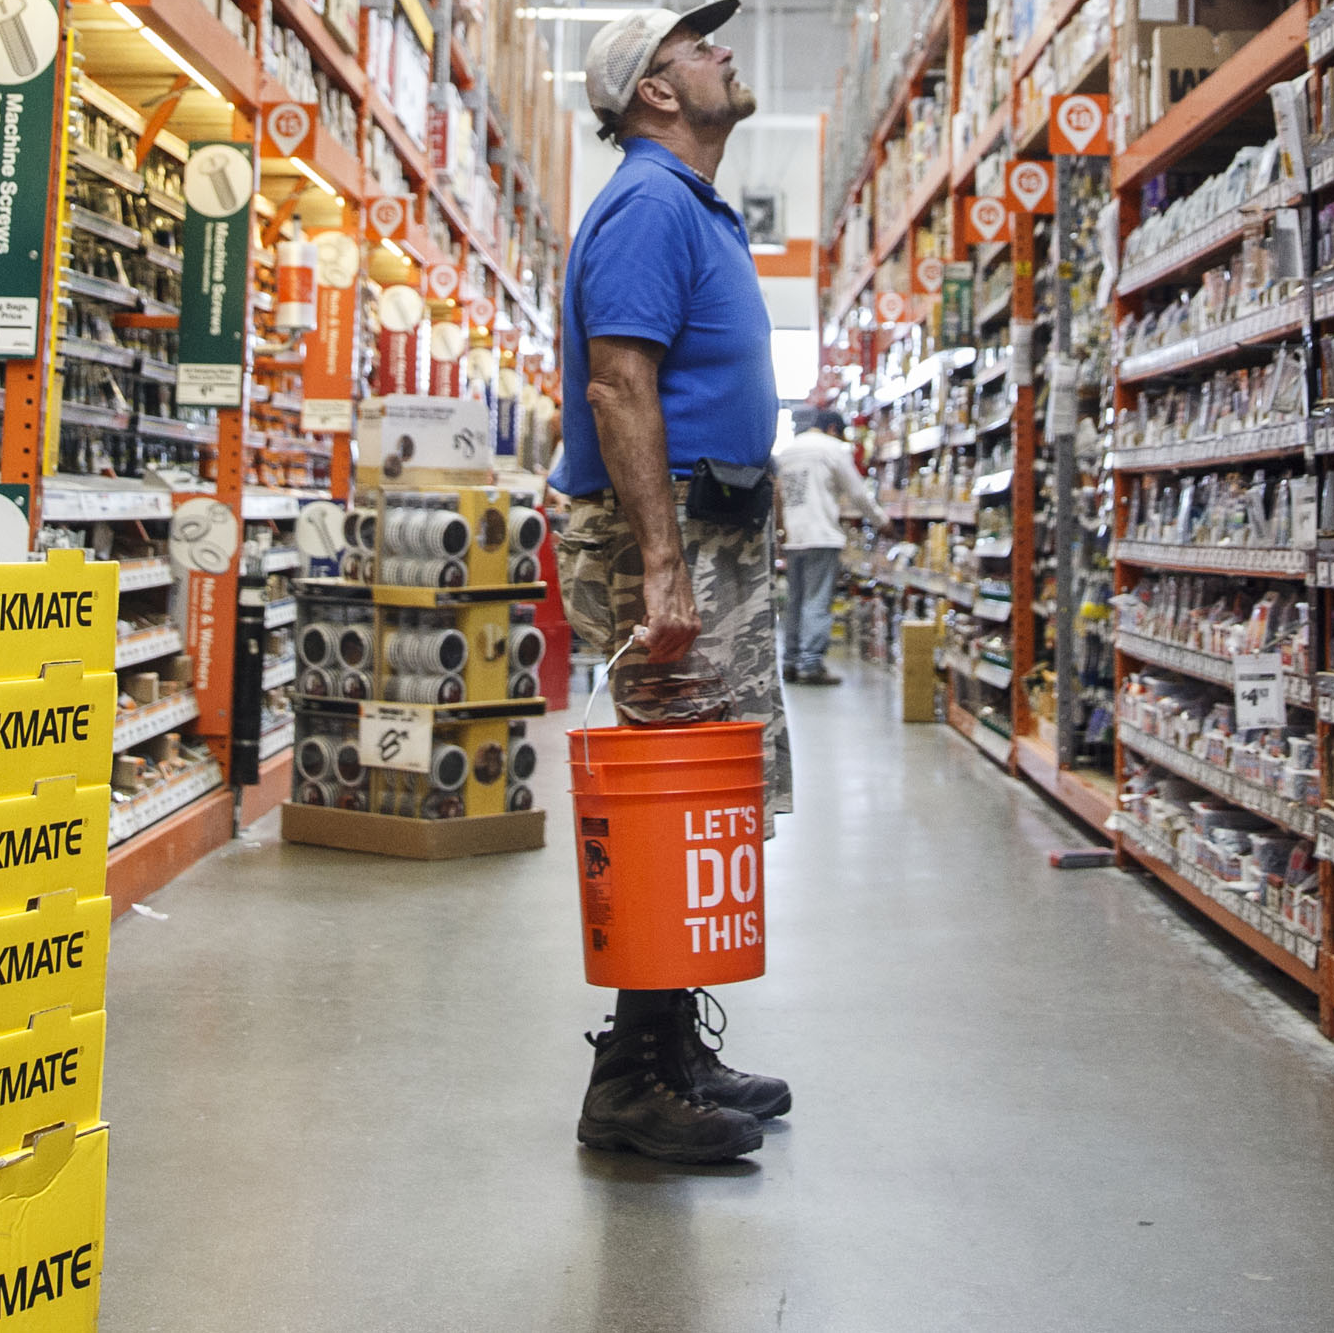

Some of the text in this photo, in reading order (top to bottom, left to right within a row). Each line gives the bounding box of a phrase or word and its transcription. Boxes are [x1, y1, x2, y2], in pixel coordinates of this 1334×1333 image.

[1, 93, 24, 178] Machine
[684, 805, 756, 840] LET'S
[686, 844, 757, 909] DO
